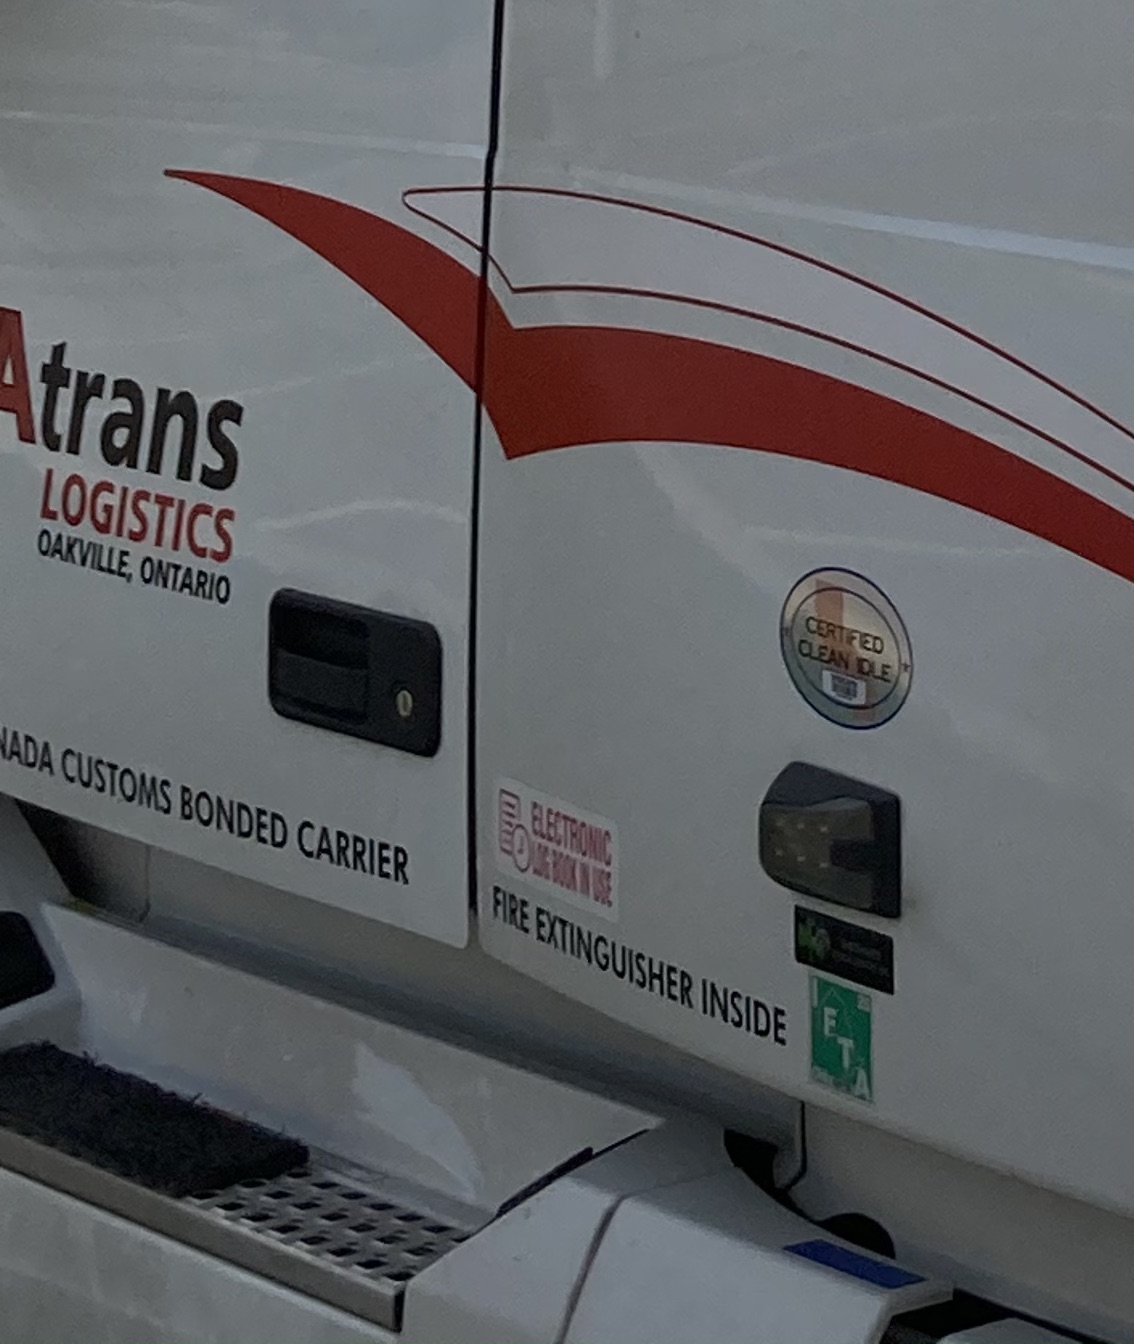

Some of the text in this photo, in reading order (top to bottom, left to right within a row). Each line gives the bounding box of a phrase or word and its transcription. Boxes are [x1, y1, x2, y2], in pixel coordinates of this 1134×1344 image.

[40, 468, 236, 563] LOGISTICS
[37, 529, 231, 605] OAKVILLE, ONTARIO
[798, 639, 893, 684] CLEAN IDLE
[805, 616, 885, 655] CERTIFIED
[61, 748, 172, 814] CUSTOMS
[180, 785, 288, 849] BONDED
[298, 820, 410, 885] CARRIER
[531, 800, 612, 866] ELECTRONIC
[492, 885, 787, 1046] FIRE EXTINGUISHER INSIDE
